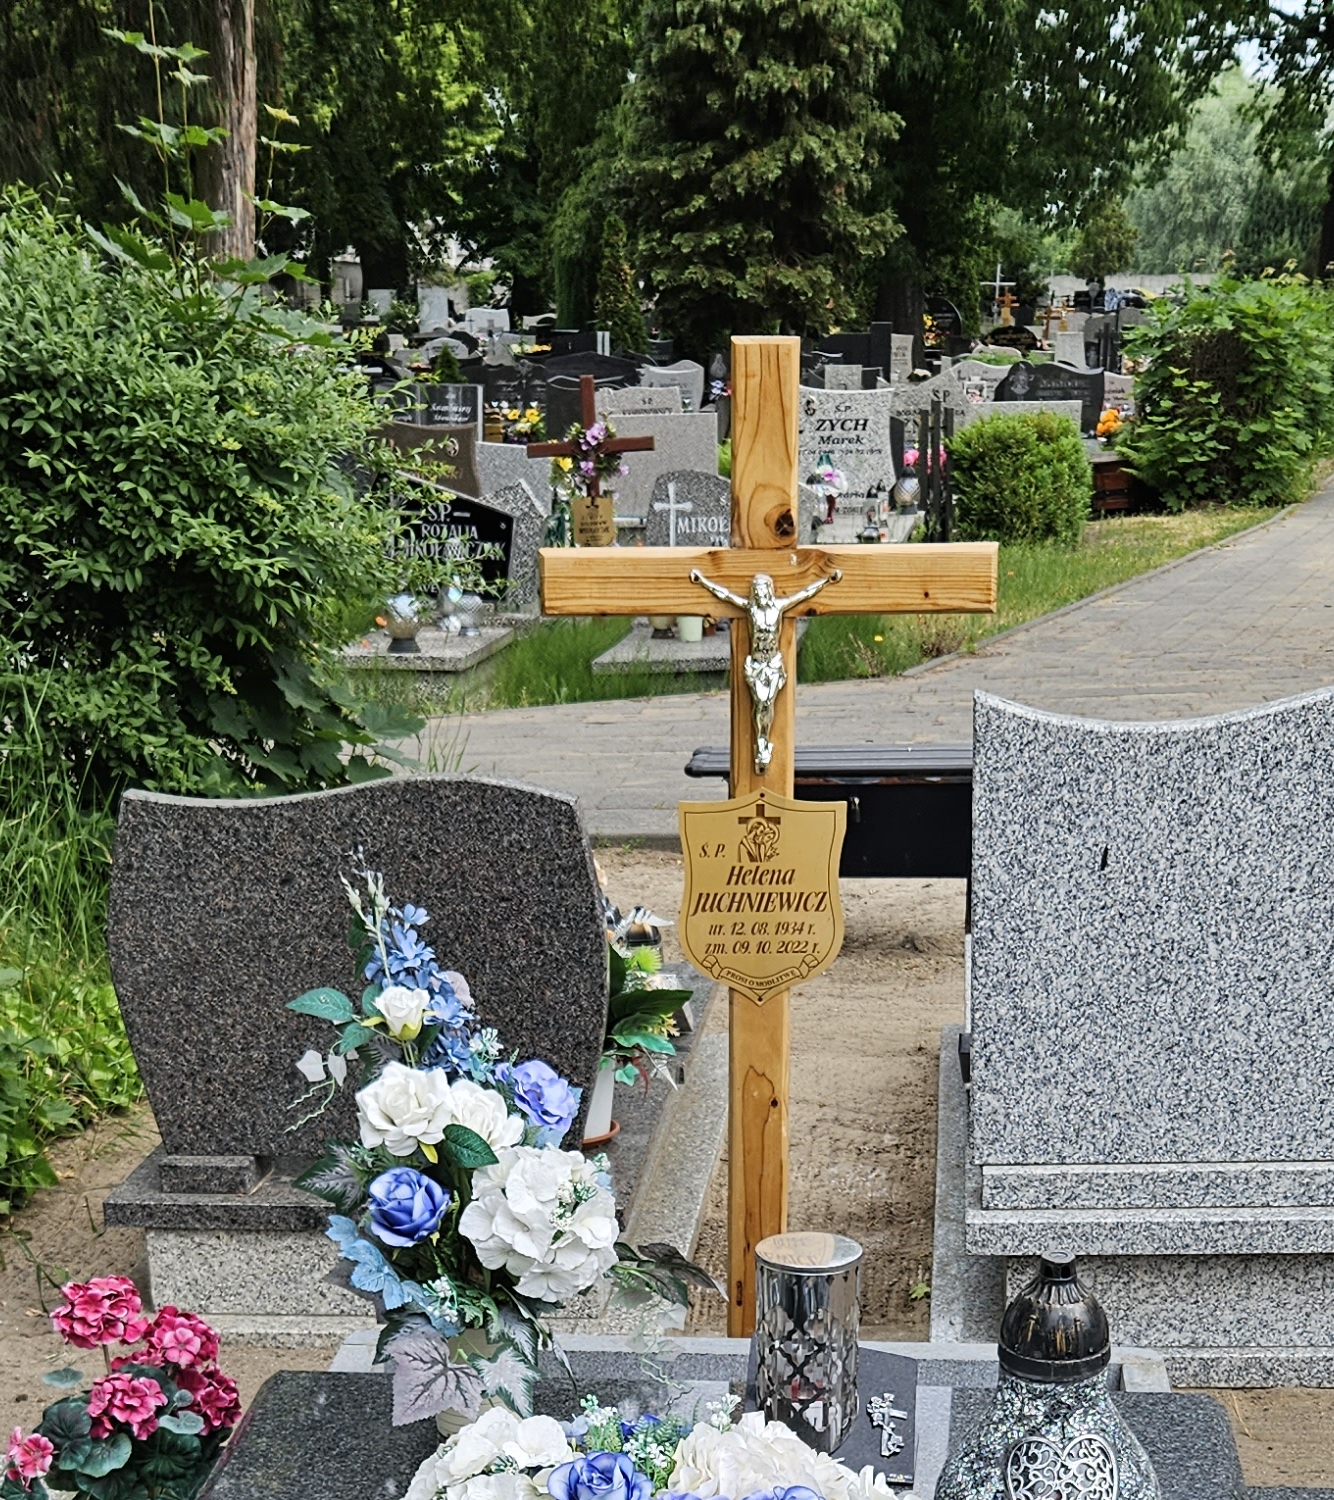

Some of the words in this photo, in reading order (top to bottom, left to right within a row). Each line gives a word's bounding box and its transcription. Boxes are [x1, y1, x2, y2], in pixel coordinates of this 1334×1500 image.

[815, 418, 870, 432] ZYCH
[817, 434, 865, 446] Marek
[677, 516, 730, 534] MIKOŁ
[725, 865, 796, 887] Helena
[690, 890, 828, 917] JUCHNIEWICZ
[708, 922, 726, 936] ur.
[730, 921, 747, 936] 12.
[751, 921, 770, 936] 08.
[774, 921, 805, 936] 1934
[807, 922, 816, 936] r.
[704, 942, 728, 955] zm.
[732, 940, 751, 955] 09.
[755, 940, 772, 955] 10.
[776, 941, 809, 955] 2022
[811, 941, 821, 955] r.
